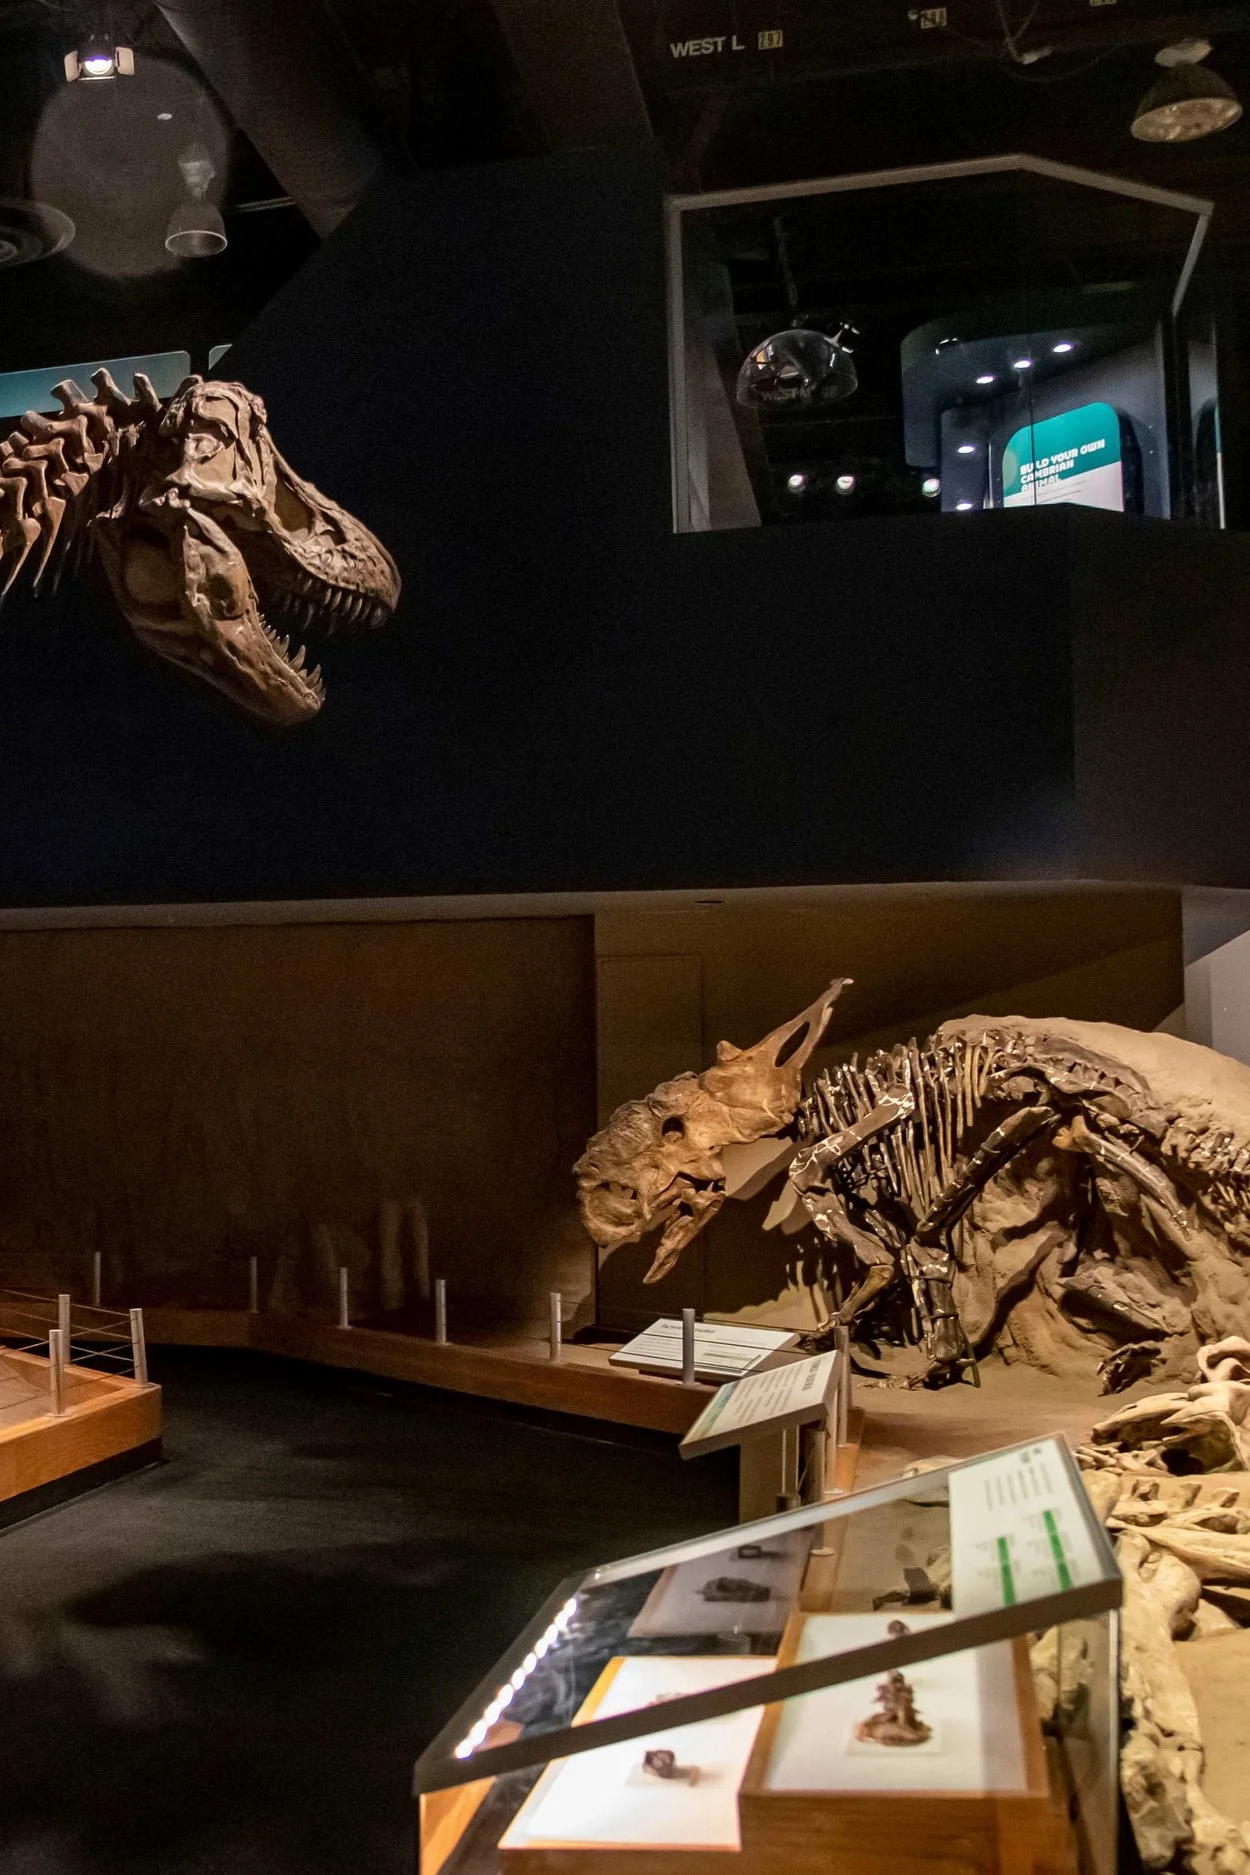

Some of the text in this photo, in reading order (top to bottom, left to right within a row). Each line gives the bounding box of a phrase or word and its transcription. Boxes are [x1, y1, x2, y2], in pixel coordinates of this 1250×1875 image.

[670, 36, 726, 58] WEST
[731, 34, 745, 51] L
[1020, 439, 1105, 475] BULD YOUR OWN
